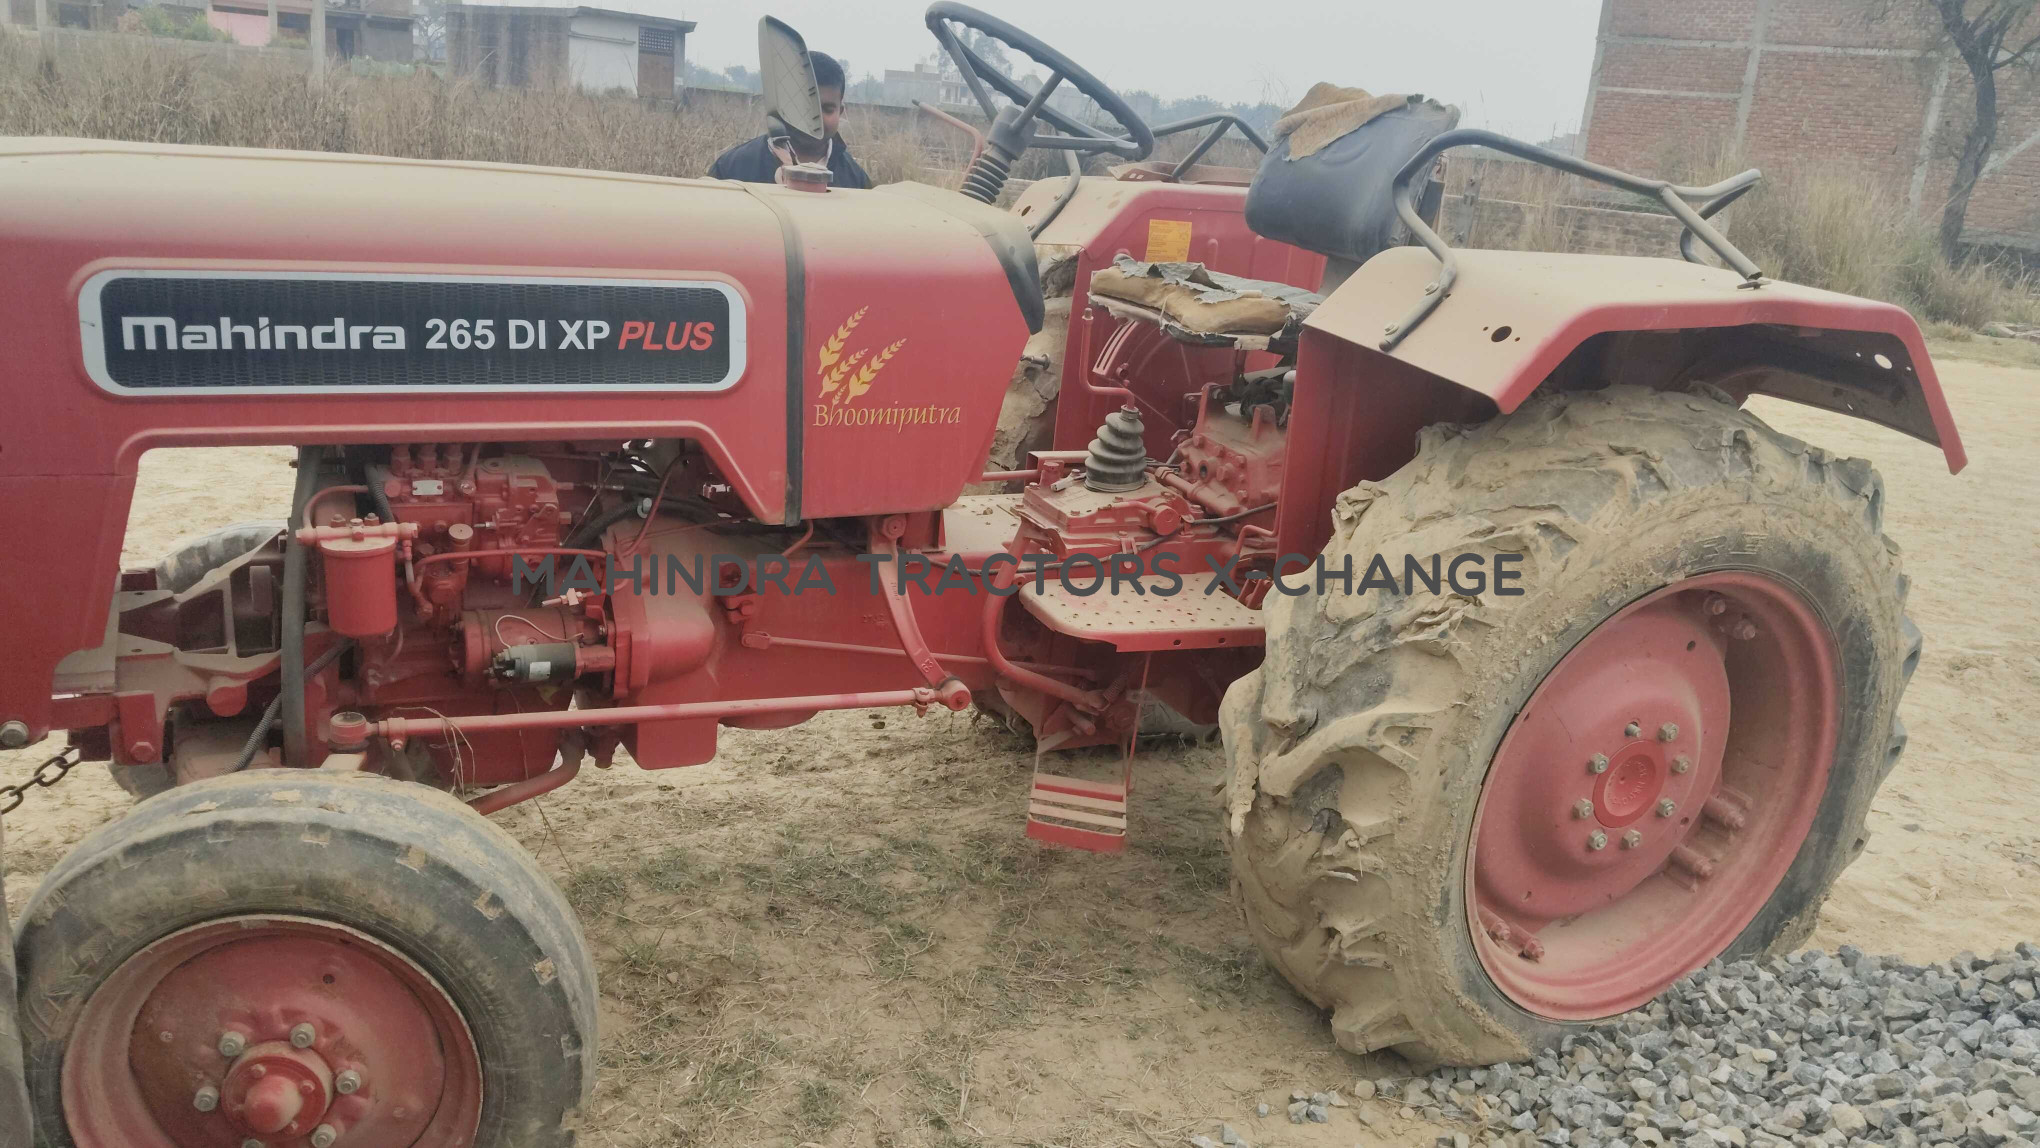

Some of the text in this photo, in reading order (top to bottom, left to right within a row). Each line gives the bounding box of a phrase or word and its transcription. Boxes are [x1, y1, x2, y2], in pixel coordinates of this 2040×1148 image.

[121, 316, 715, 351] Mahindra 265 DI XP PLUS
[812, 400, 962, 434] Bhoomiputra
